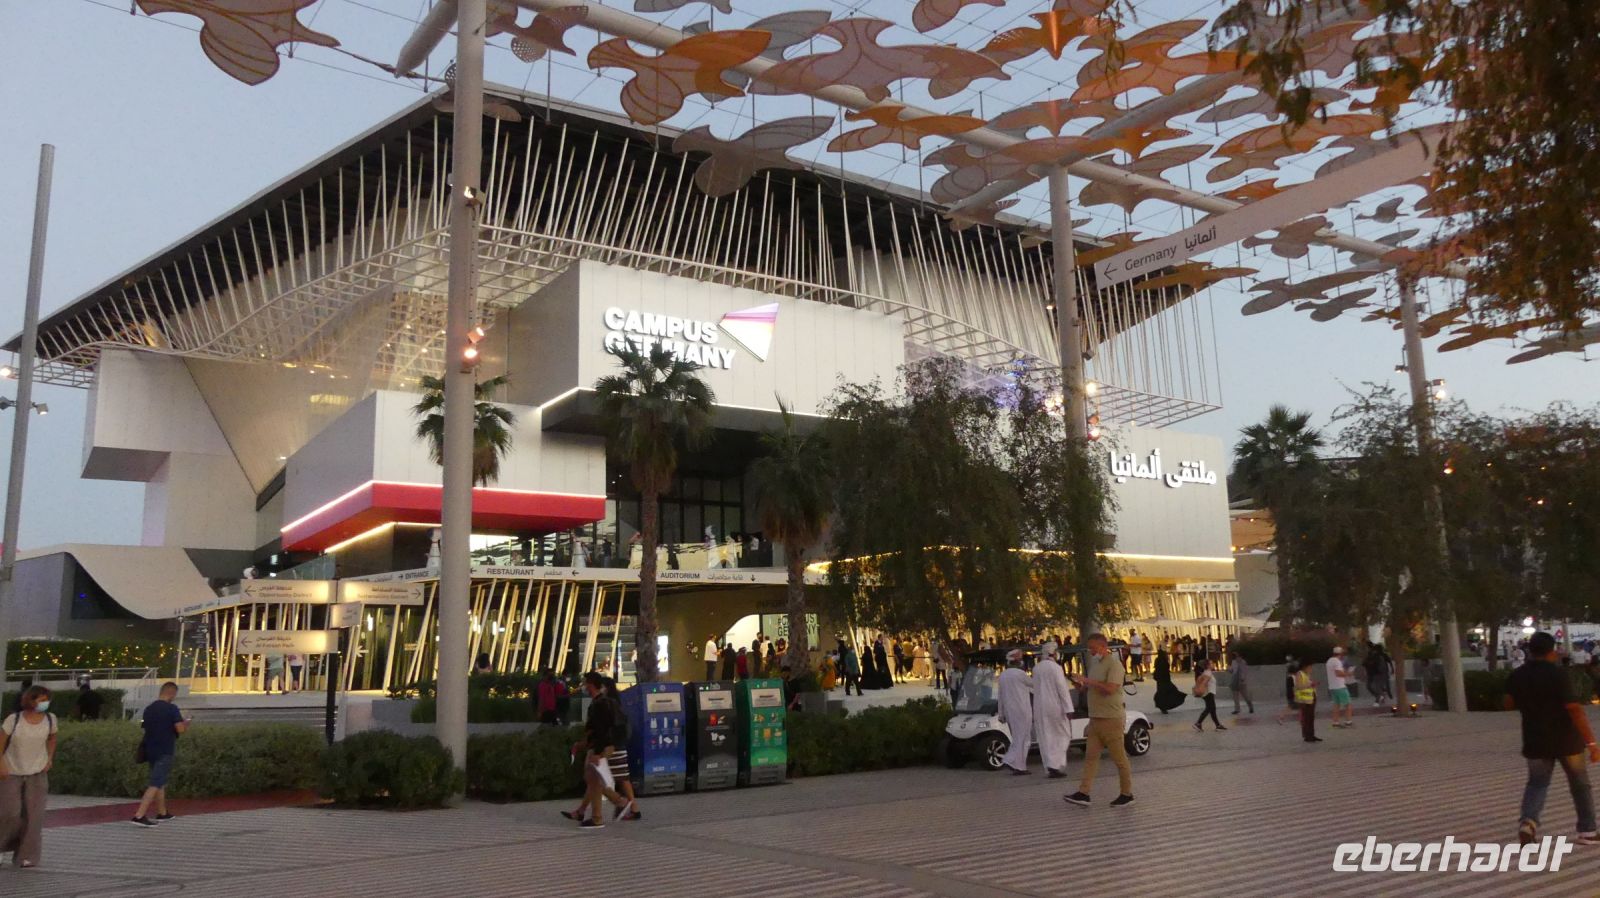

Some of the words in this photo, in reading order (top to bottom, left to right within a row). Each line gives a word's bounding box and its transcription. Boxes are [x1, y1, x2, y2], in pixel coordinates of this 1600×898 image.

[1184, 224, 1217, 253] ألمانيا
[1124, 244, 1178, 272] Germany
[603, 306, 719, 344] CAMPUS
[1109, 447, 1162, 484] ألمانيا
[1165, 460, 1217, 489] ملتقى
[405, 570, 431, 579] ENTRANCE
[486, 567, 535, 576] RESTAURANT
